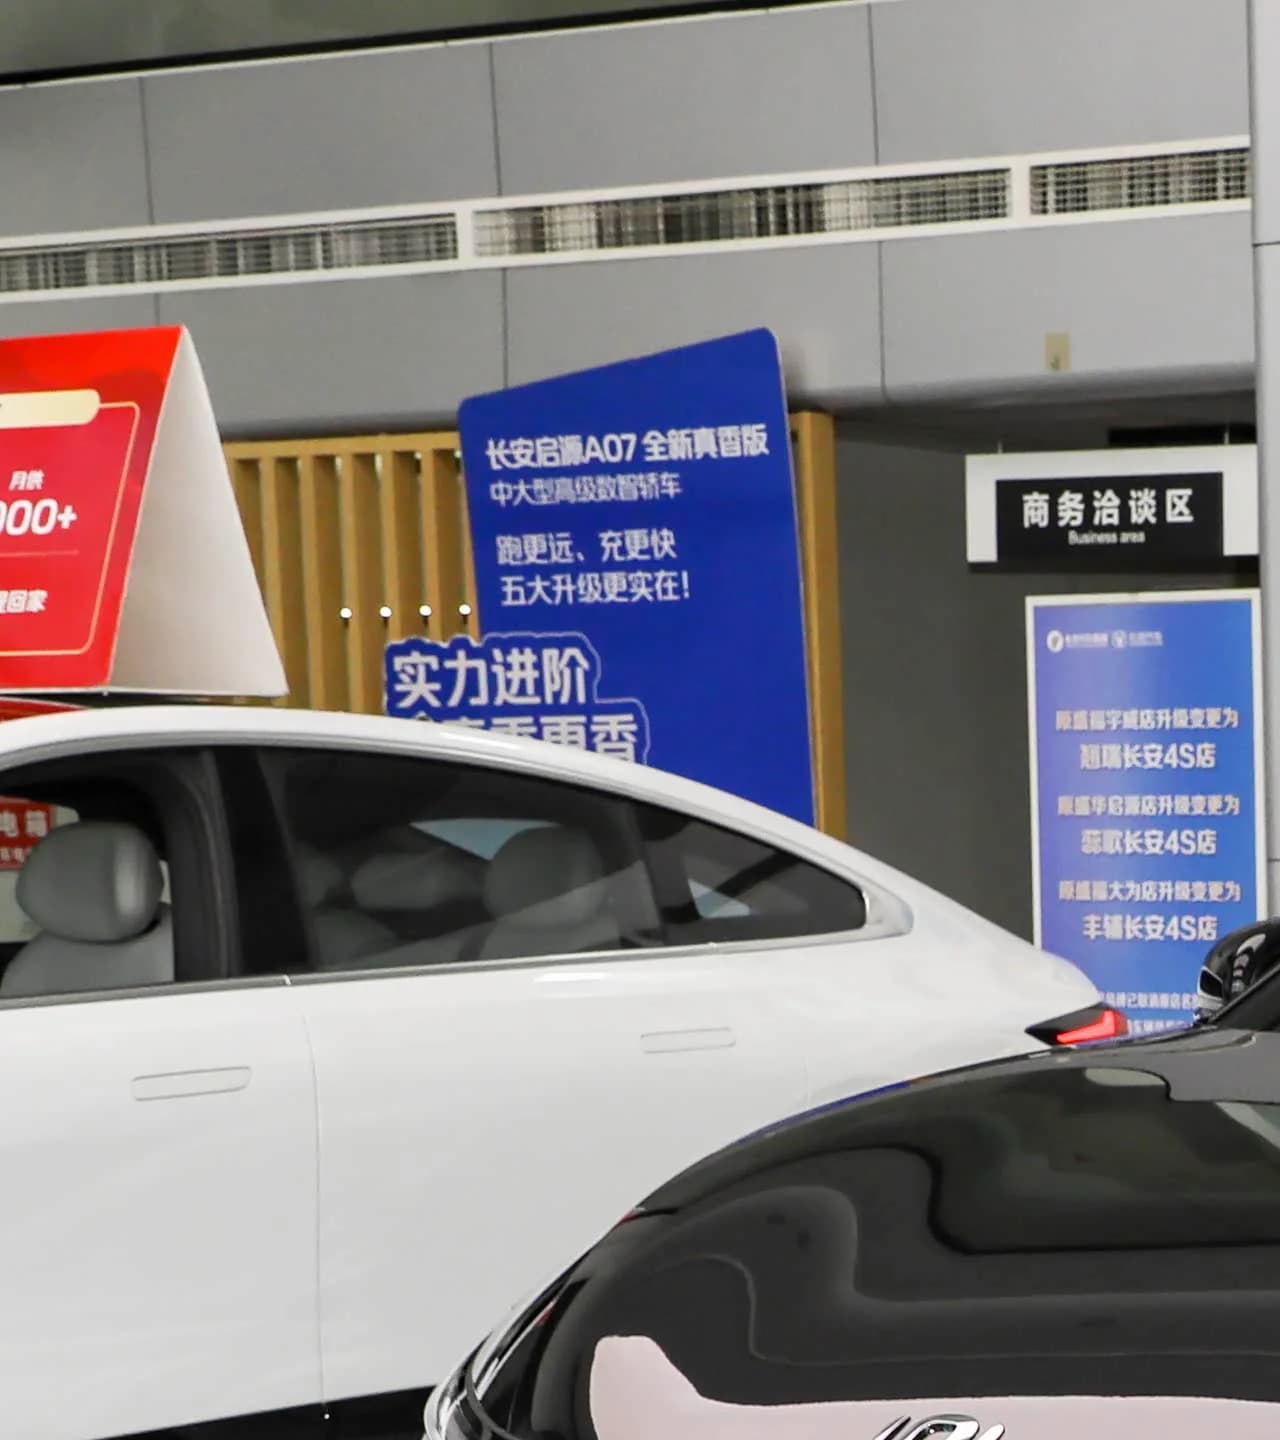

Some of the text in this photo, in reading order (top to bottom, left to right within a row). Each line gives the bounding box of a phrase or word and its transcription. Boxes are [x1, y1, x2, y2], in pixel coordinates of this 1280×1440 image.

[486, 424, 770, 470] 长安启源A07 全新真香版
[9, 469, 44, 491] 月供
[489, 472, 682, 507] 中大型高级数智轿车
[0, 497, 77, 537] 00+
[1022, 488, 1194, 528] 商务洽谈区
[1068, 529, 1146, 545] Business area
[393, 647, 590, 709] 实力进阶
